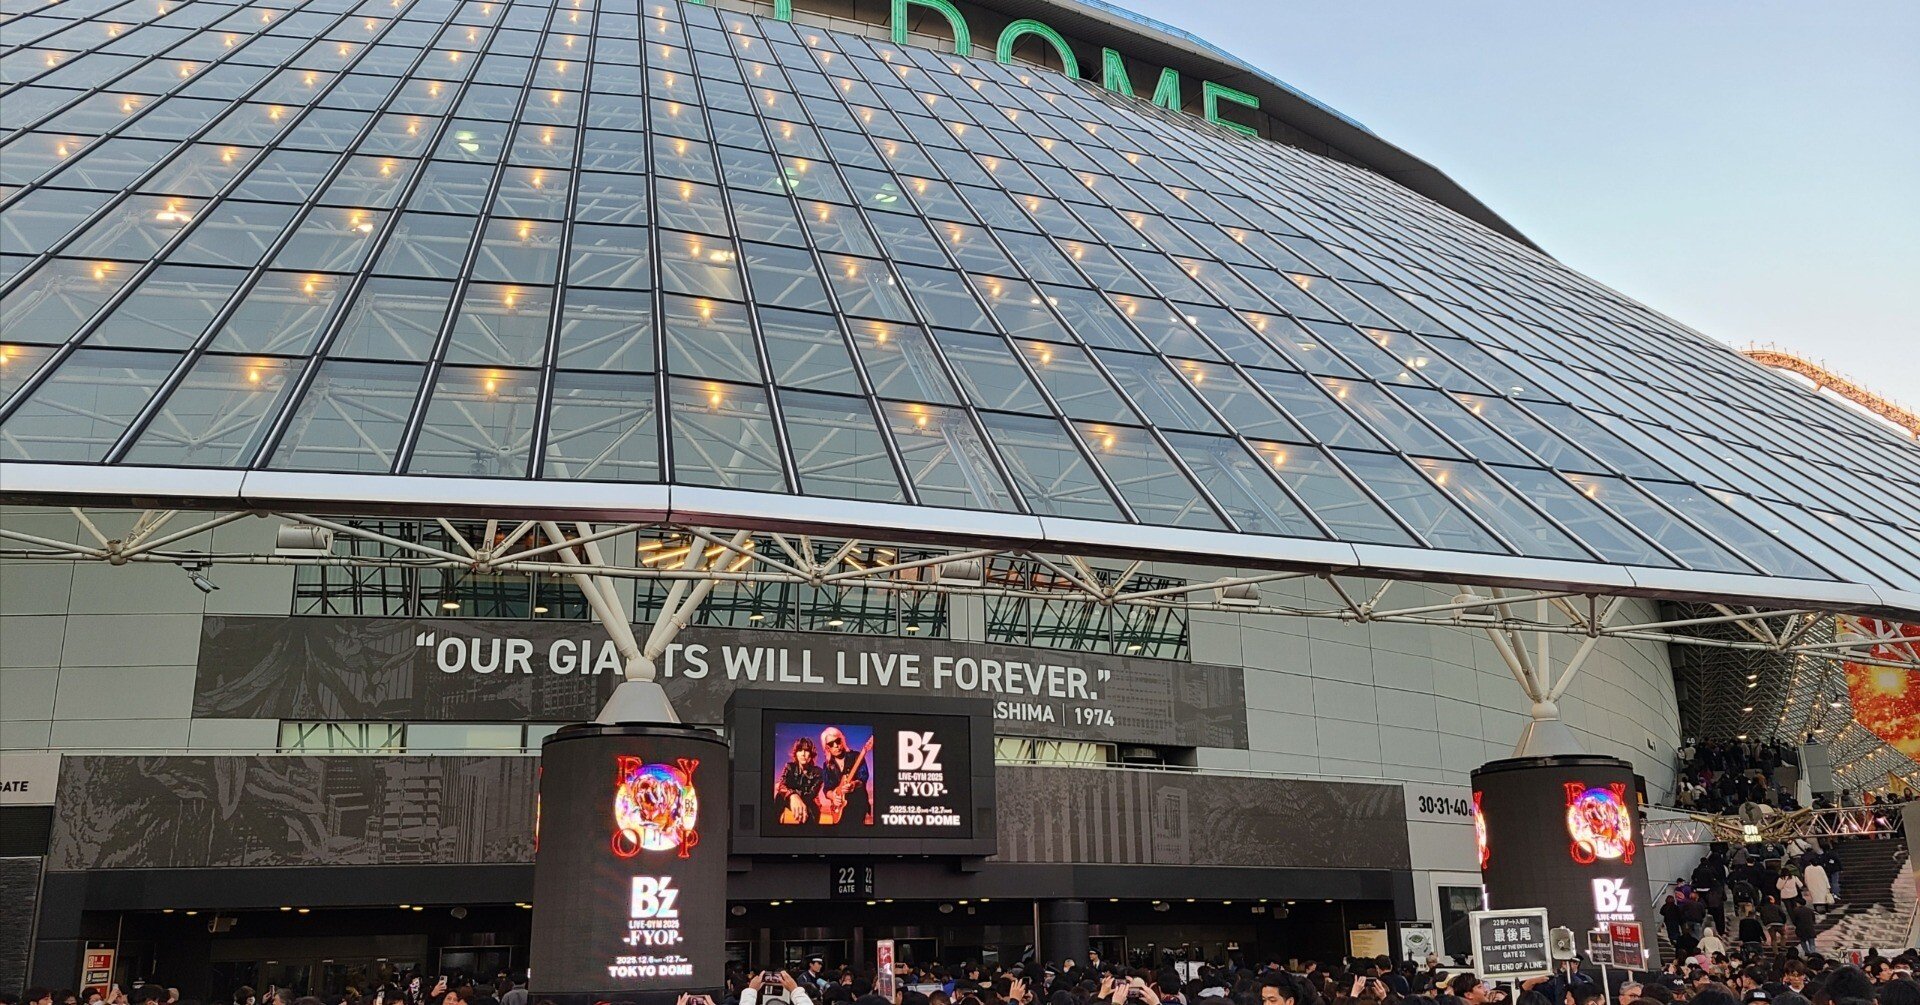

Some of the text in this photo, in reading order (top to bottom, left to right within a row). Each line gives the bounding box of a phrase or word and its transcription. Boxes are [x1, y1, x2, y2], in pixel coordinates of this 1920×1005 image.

[892, 0, 1260, 136] DOME
[549, 638, 710, 679] GIATS
[722, 645, 824, 684] WILL
[837, 650, 921, 688] LIVE
[993, 701, 1115, 727] SHIMA 1974
[898, 730, 942, 771] B'z
[898, 772, 943, 781] LIVE-GYM 2025
[881, 814, 961, 826] TOKYO DOME
[839, 867, 855, 884] 22
[631, 876, 678, 918] B'z
[838, 885, 855, 893] GATE
[1592, 878, 1633, 912] B'z
[663, 920, 680, 929] 2025
[1494, 927, 1531, 942] 最後尾
[608, 964, 692, 977] TOKYO DOME
[1501, 963, 1514, 971] END
[1515, 962, 1523, 970] OF
[1529, 961, 1543, 969] LINE
